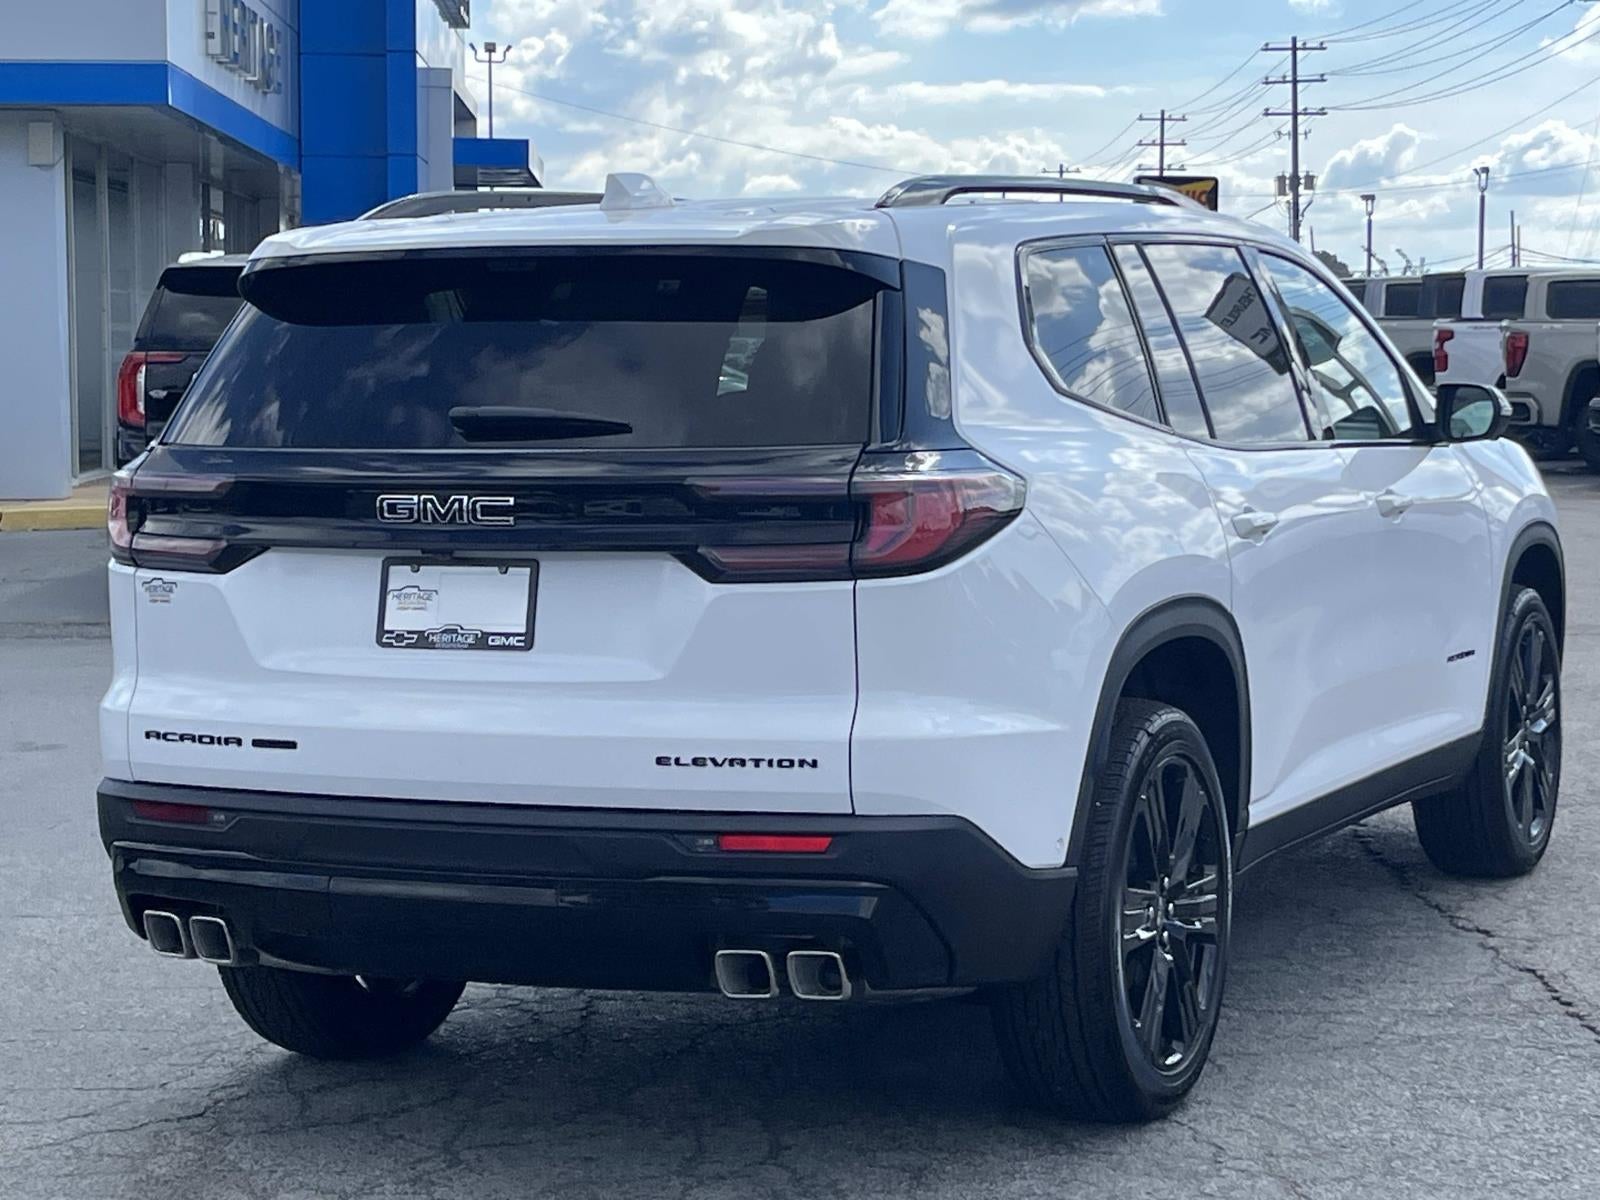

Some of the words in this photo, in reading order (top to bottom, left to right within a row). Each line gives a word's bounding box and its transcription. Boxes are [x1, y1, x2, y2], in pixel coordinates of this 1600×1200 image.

[376, 494, 515, 526] GMC
[391, 592, 433, 601] HERITAGE
[428, 634, 477, 644] HERITAGE
[487, 635, 526, 647] GMC
[144, 730, 243, 747] ACADIA
[655, 756, 818, 769] ELEVATION
